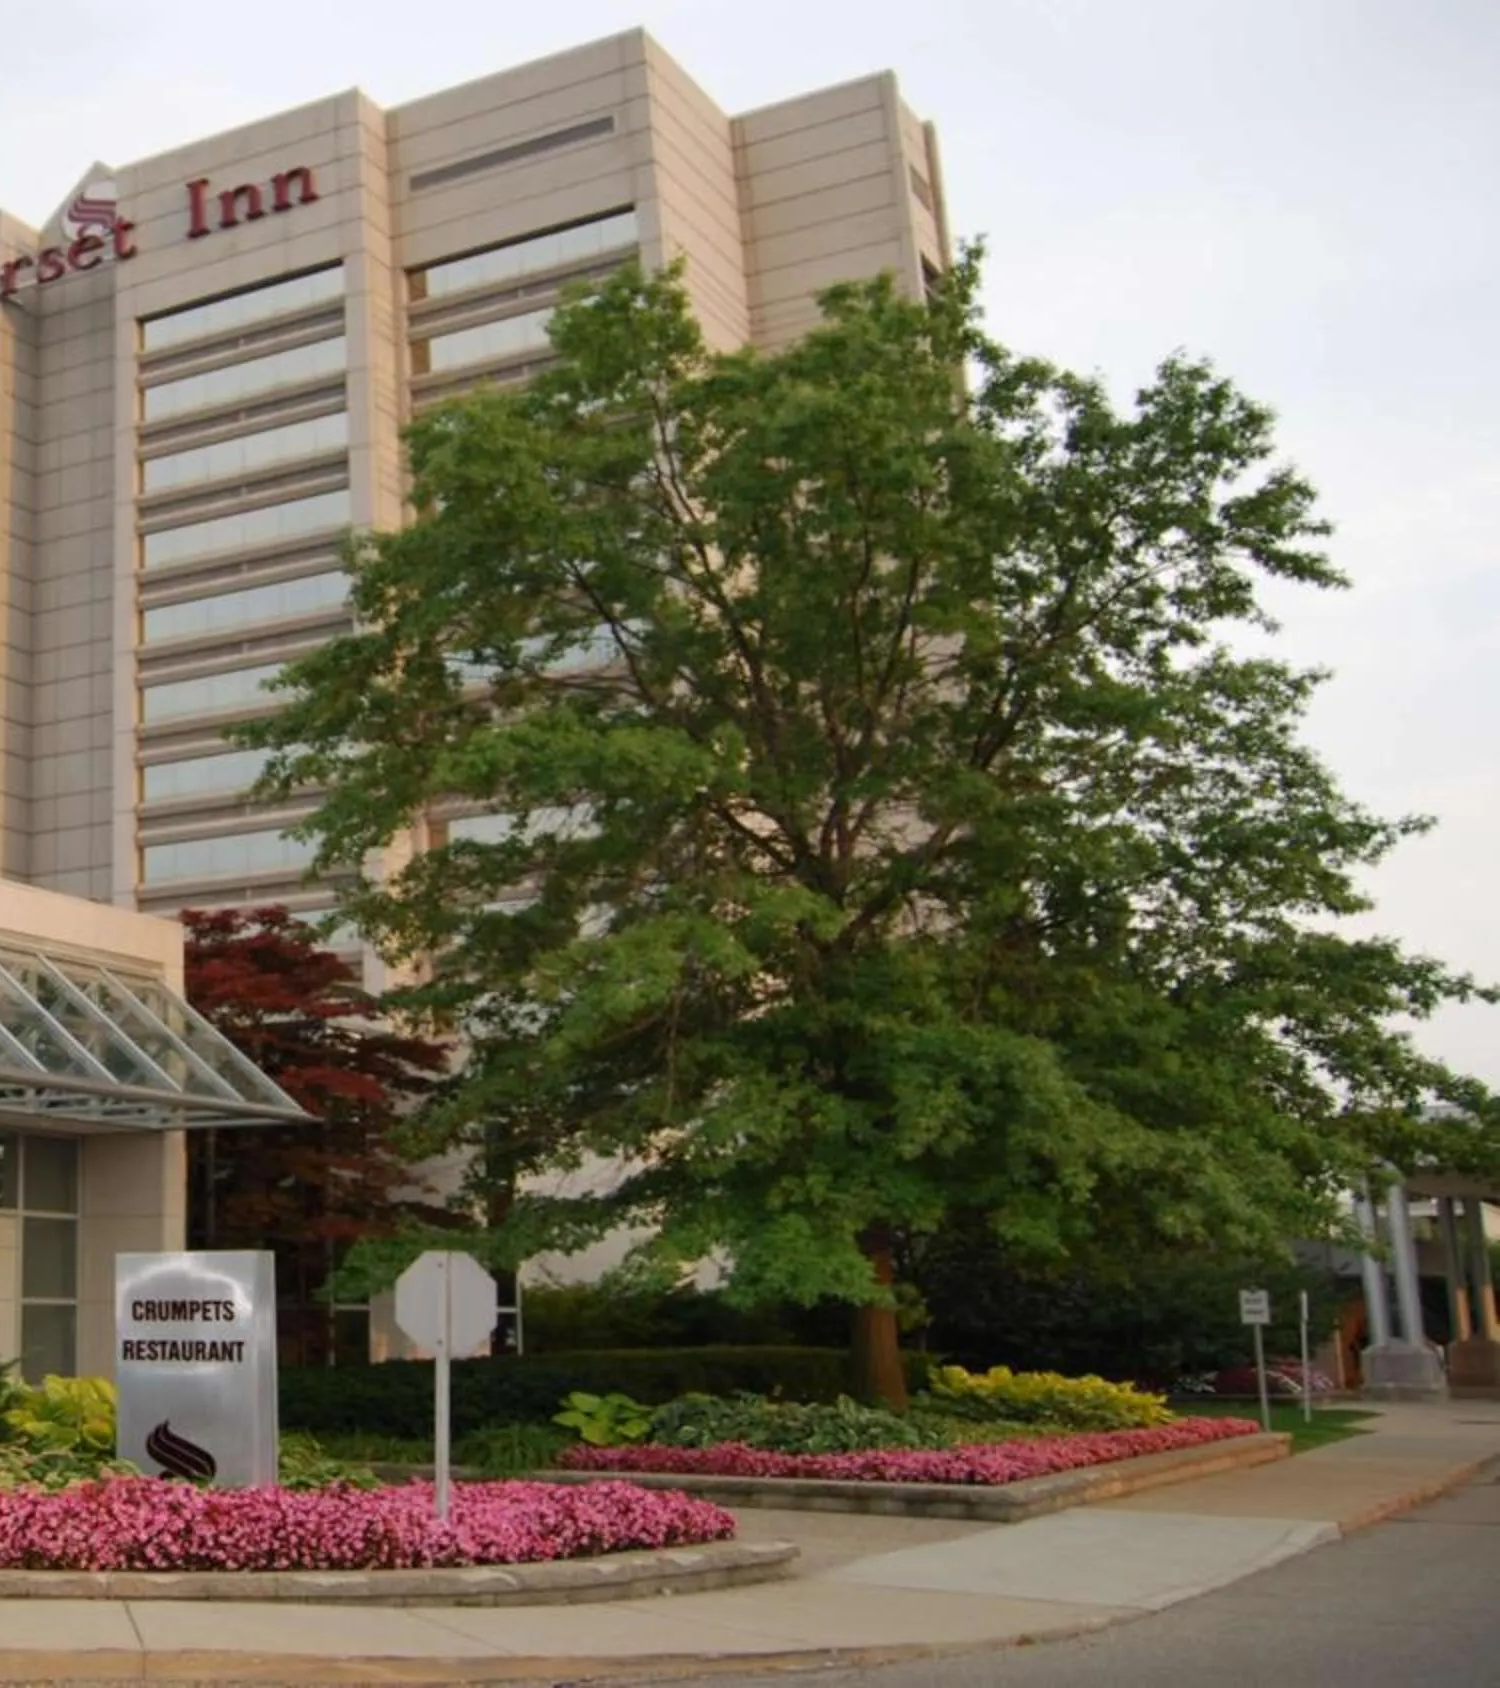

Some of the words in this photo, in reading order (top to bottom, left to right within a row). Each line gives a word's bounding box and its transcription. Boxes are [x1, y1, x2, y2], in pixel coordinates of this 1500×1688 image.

[186, 165, 320, 239] Inn
[131, 1299, 235, 1322] CRUMPETS
[122, 1339, 245, 1363] RESTAURANT
